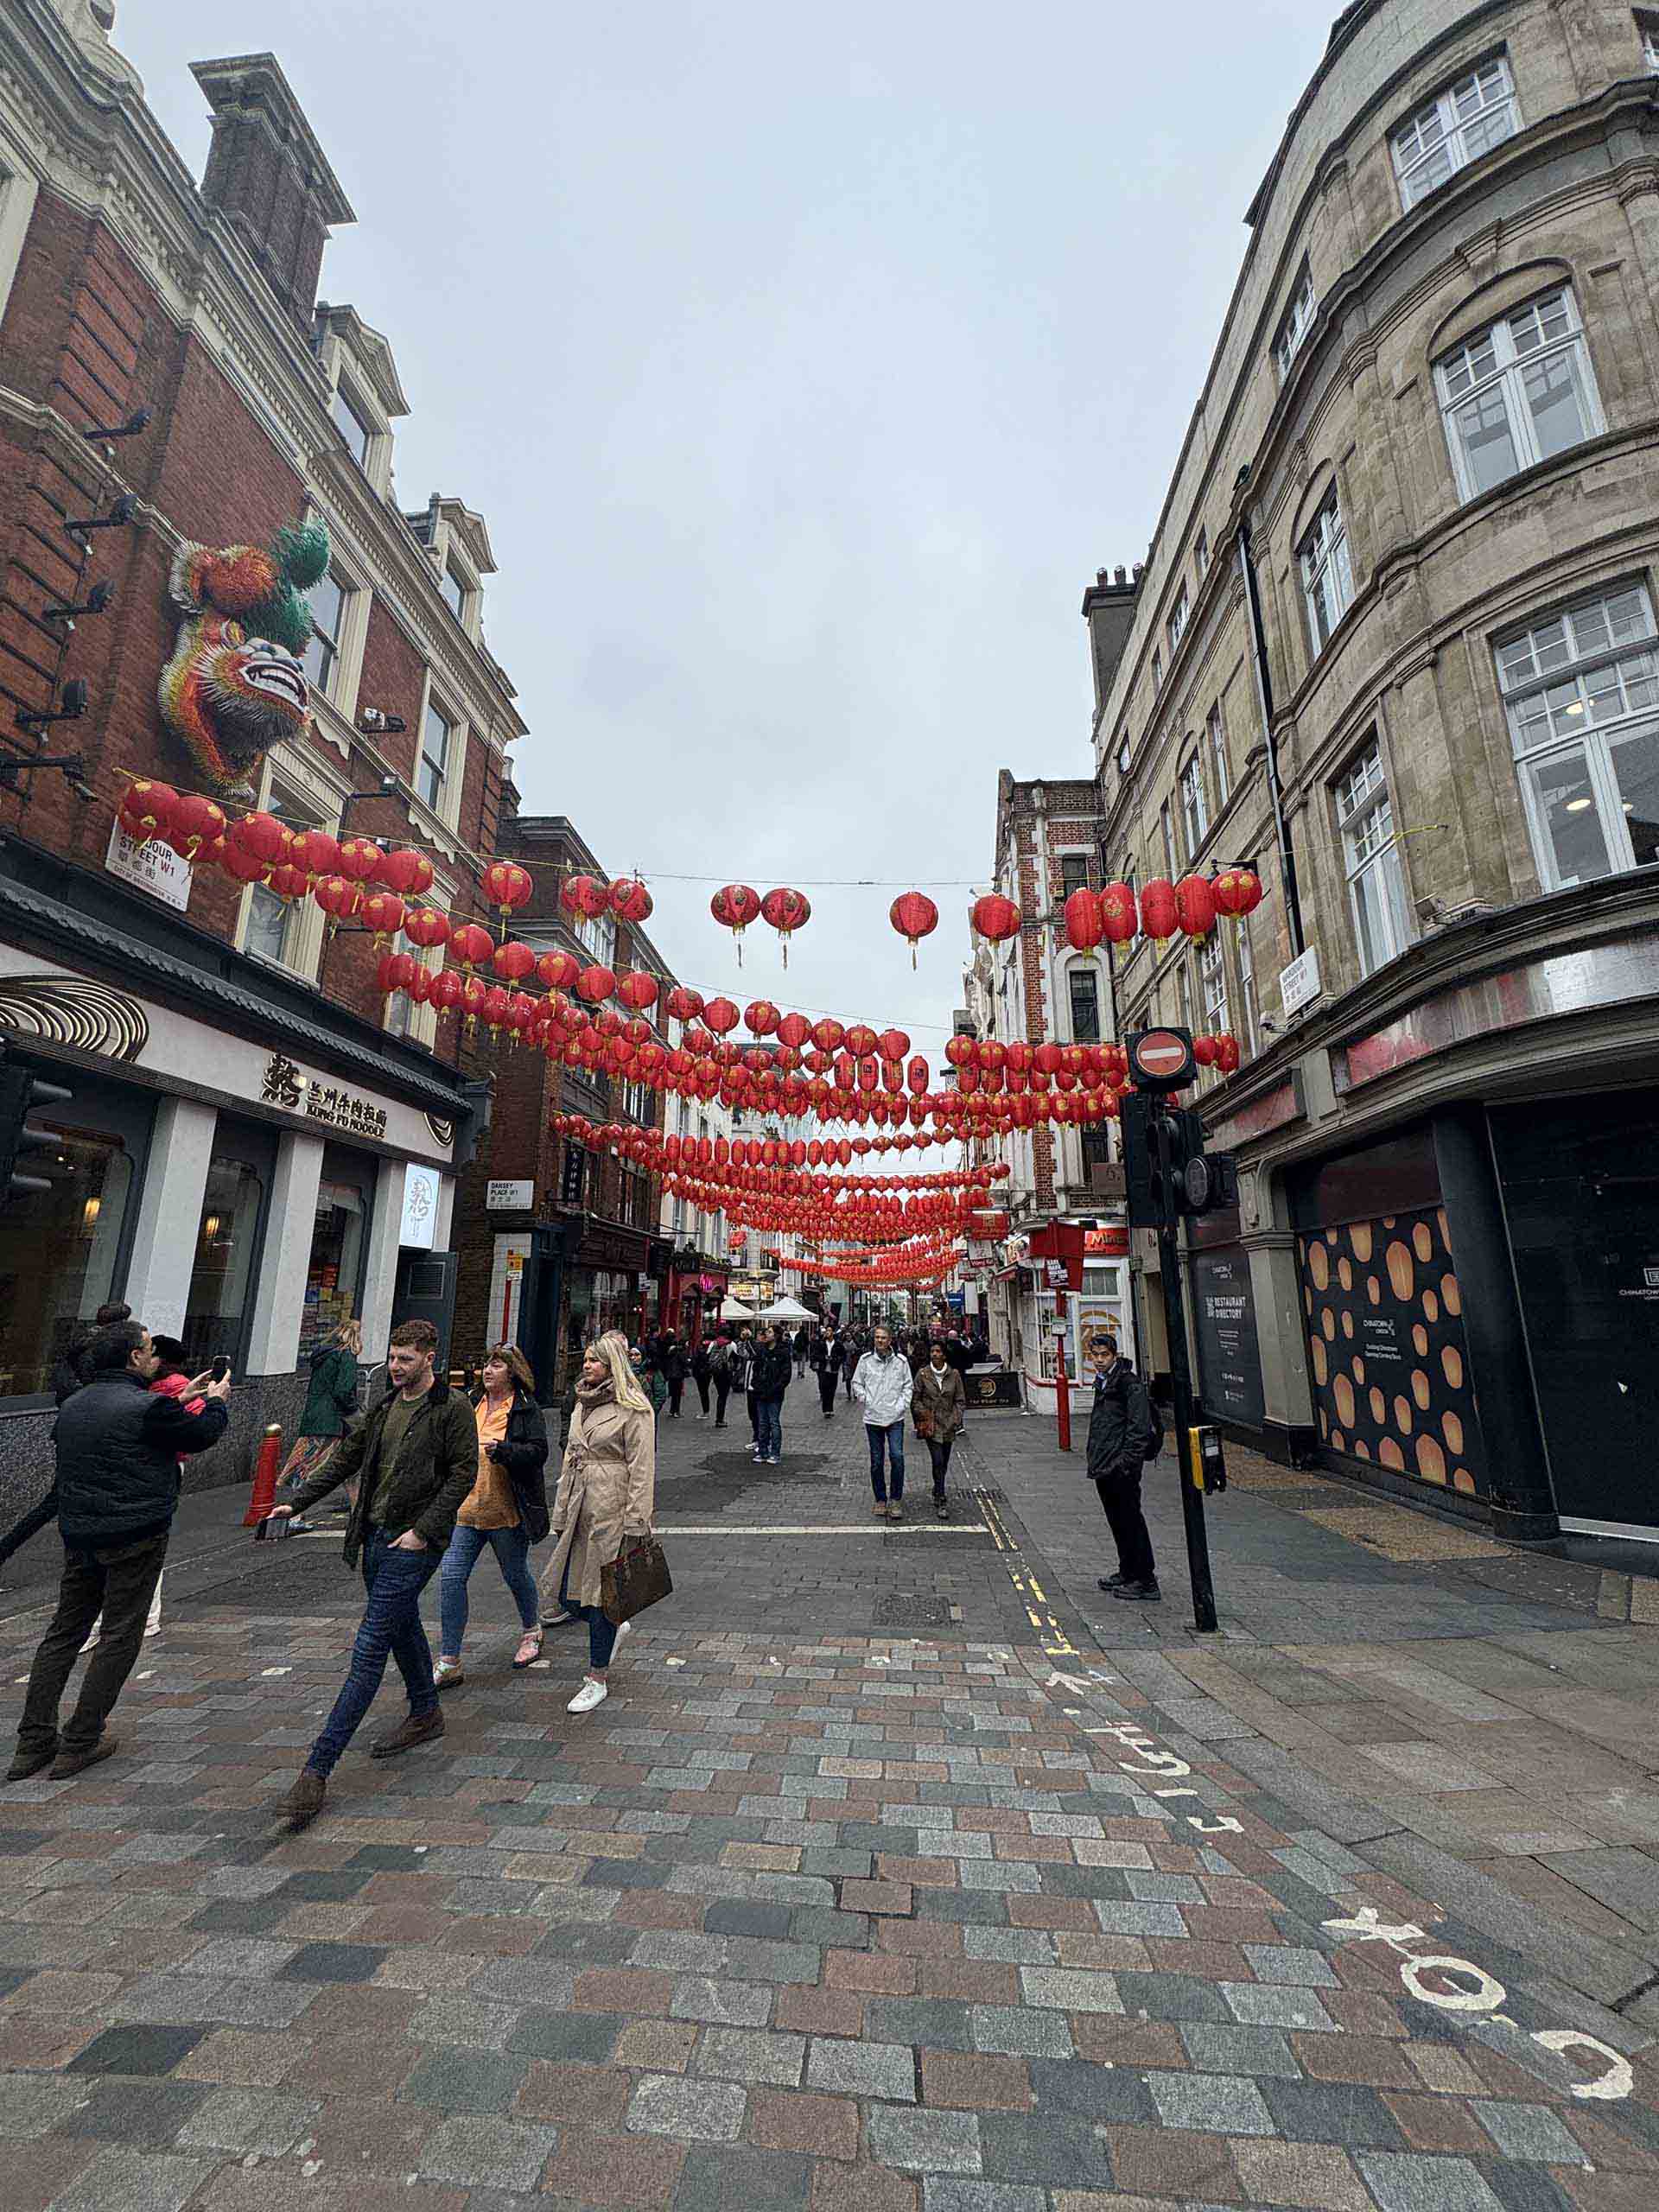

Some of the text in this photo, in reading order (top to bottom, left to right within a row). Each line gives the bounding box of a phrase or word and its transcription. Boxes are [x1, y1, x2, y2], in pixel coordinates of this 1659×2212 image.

[161, 860, 175, 876] W1
[1214, 1296, 1246, 1307] RESTAURANT
[1215, 1308, 1243, 1319] DIRECTORY
